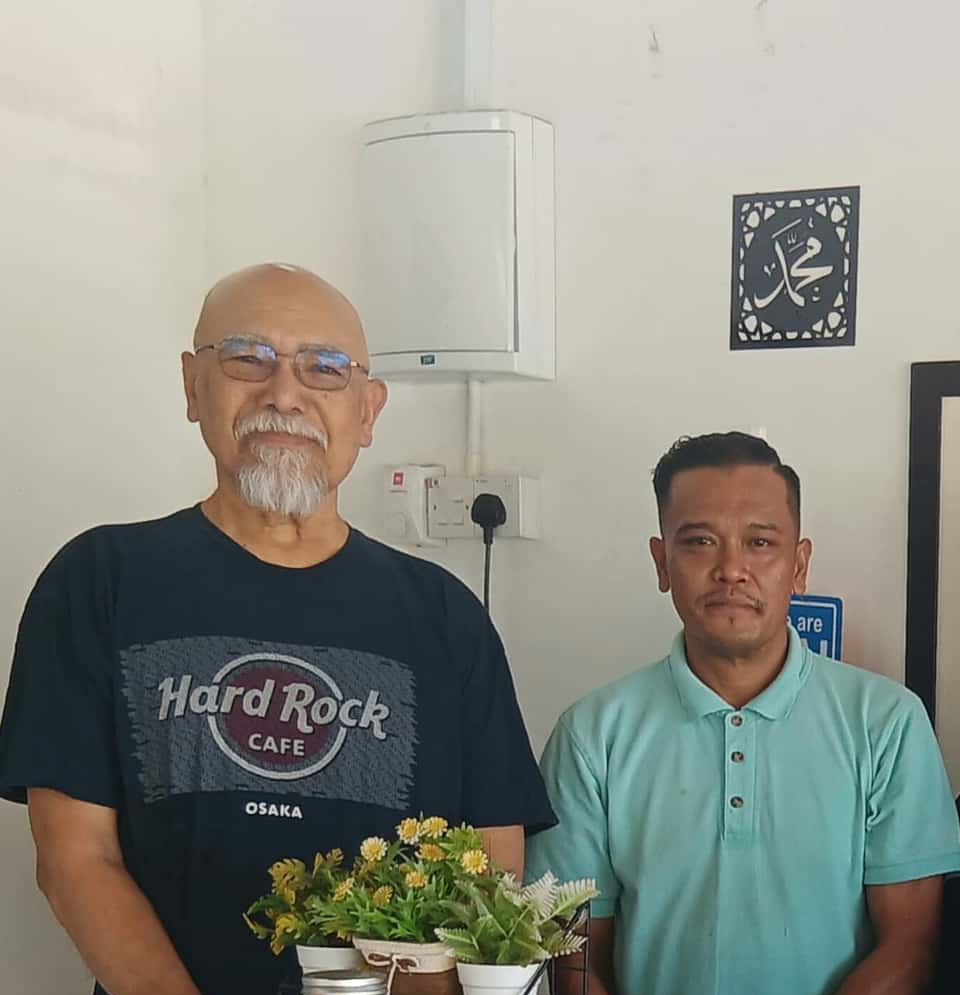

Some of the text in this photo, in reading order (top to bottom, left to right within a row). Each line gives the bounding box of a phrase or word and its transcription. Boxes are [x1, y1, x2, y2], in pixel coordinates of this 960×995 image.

[797, 616, 823, 633] are
[158, 674, 390, 740] Hard Rock
[248, 733, 306, 756] CAFE
[245, 801, 303, 819] OSAKA
